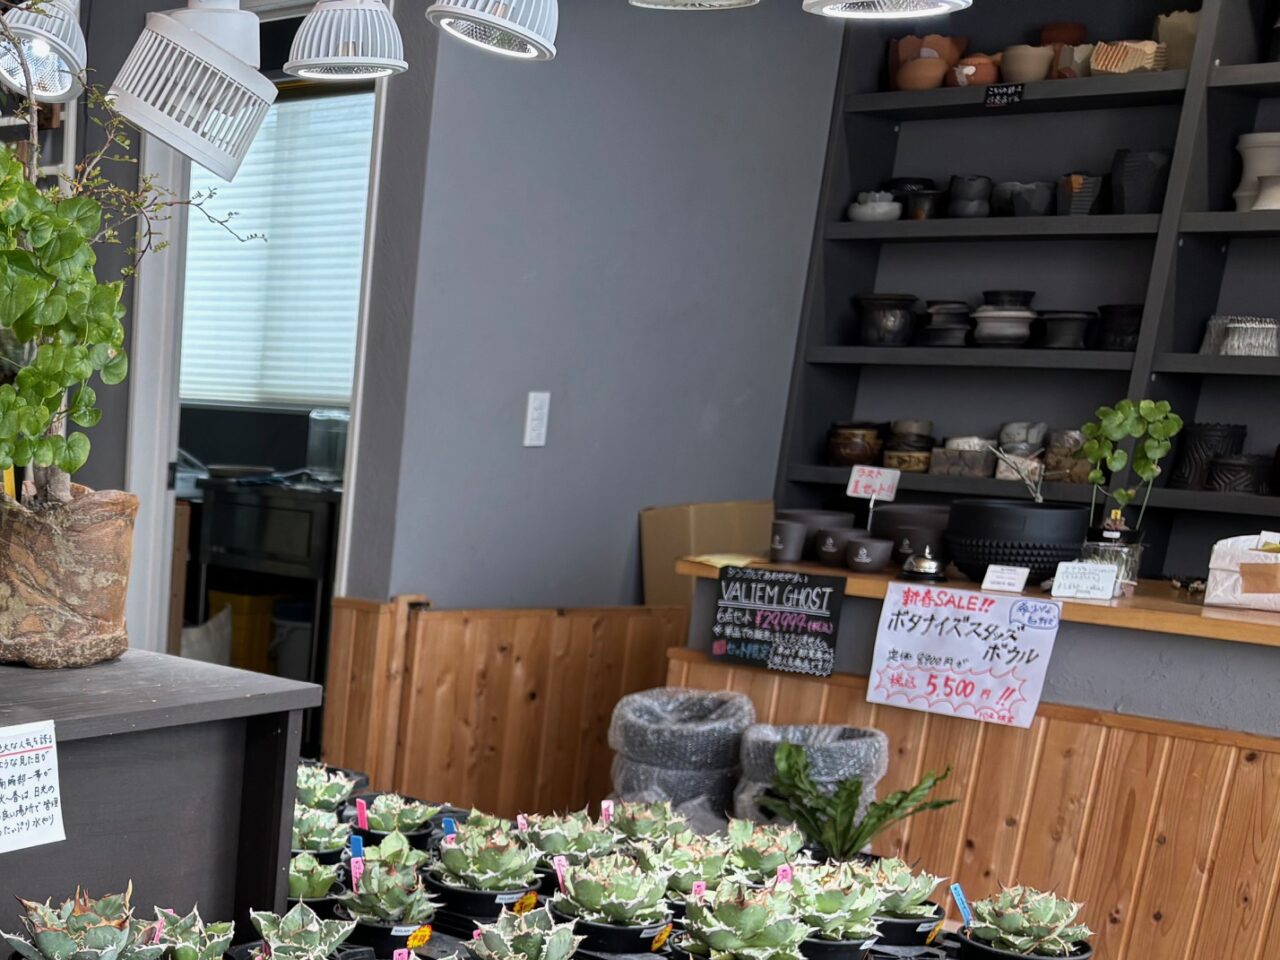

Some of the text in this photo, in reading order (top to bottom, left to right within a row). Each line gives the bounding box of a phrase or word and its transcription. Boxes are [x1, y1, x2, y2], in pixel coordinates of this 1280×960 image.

[783, 585, 834, 611] GHOST
[982, 644, 1040, 666] ボウル
